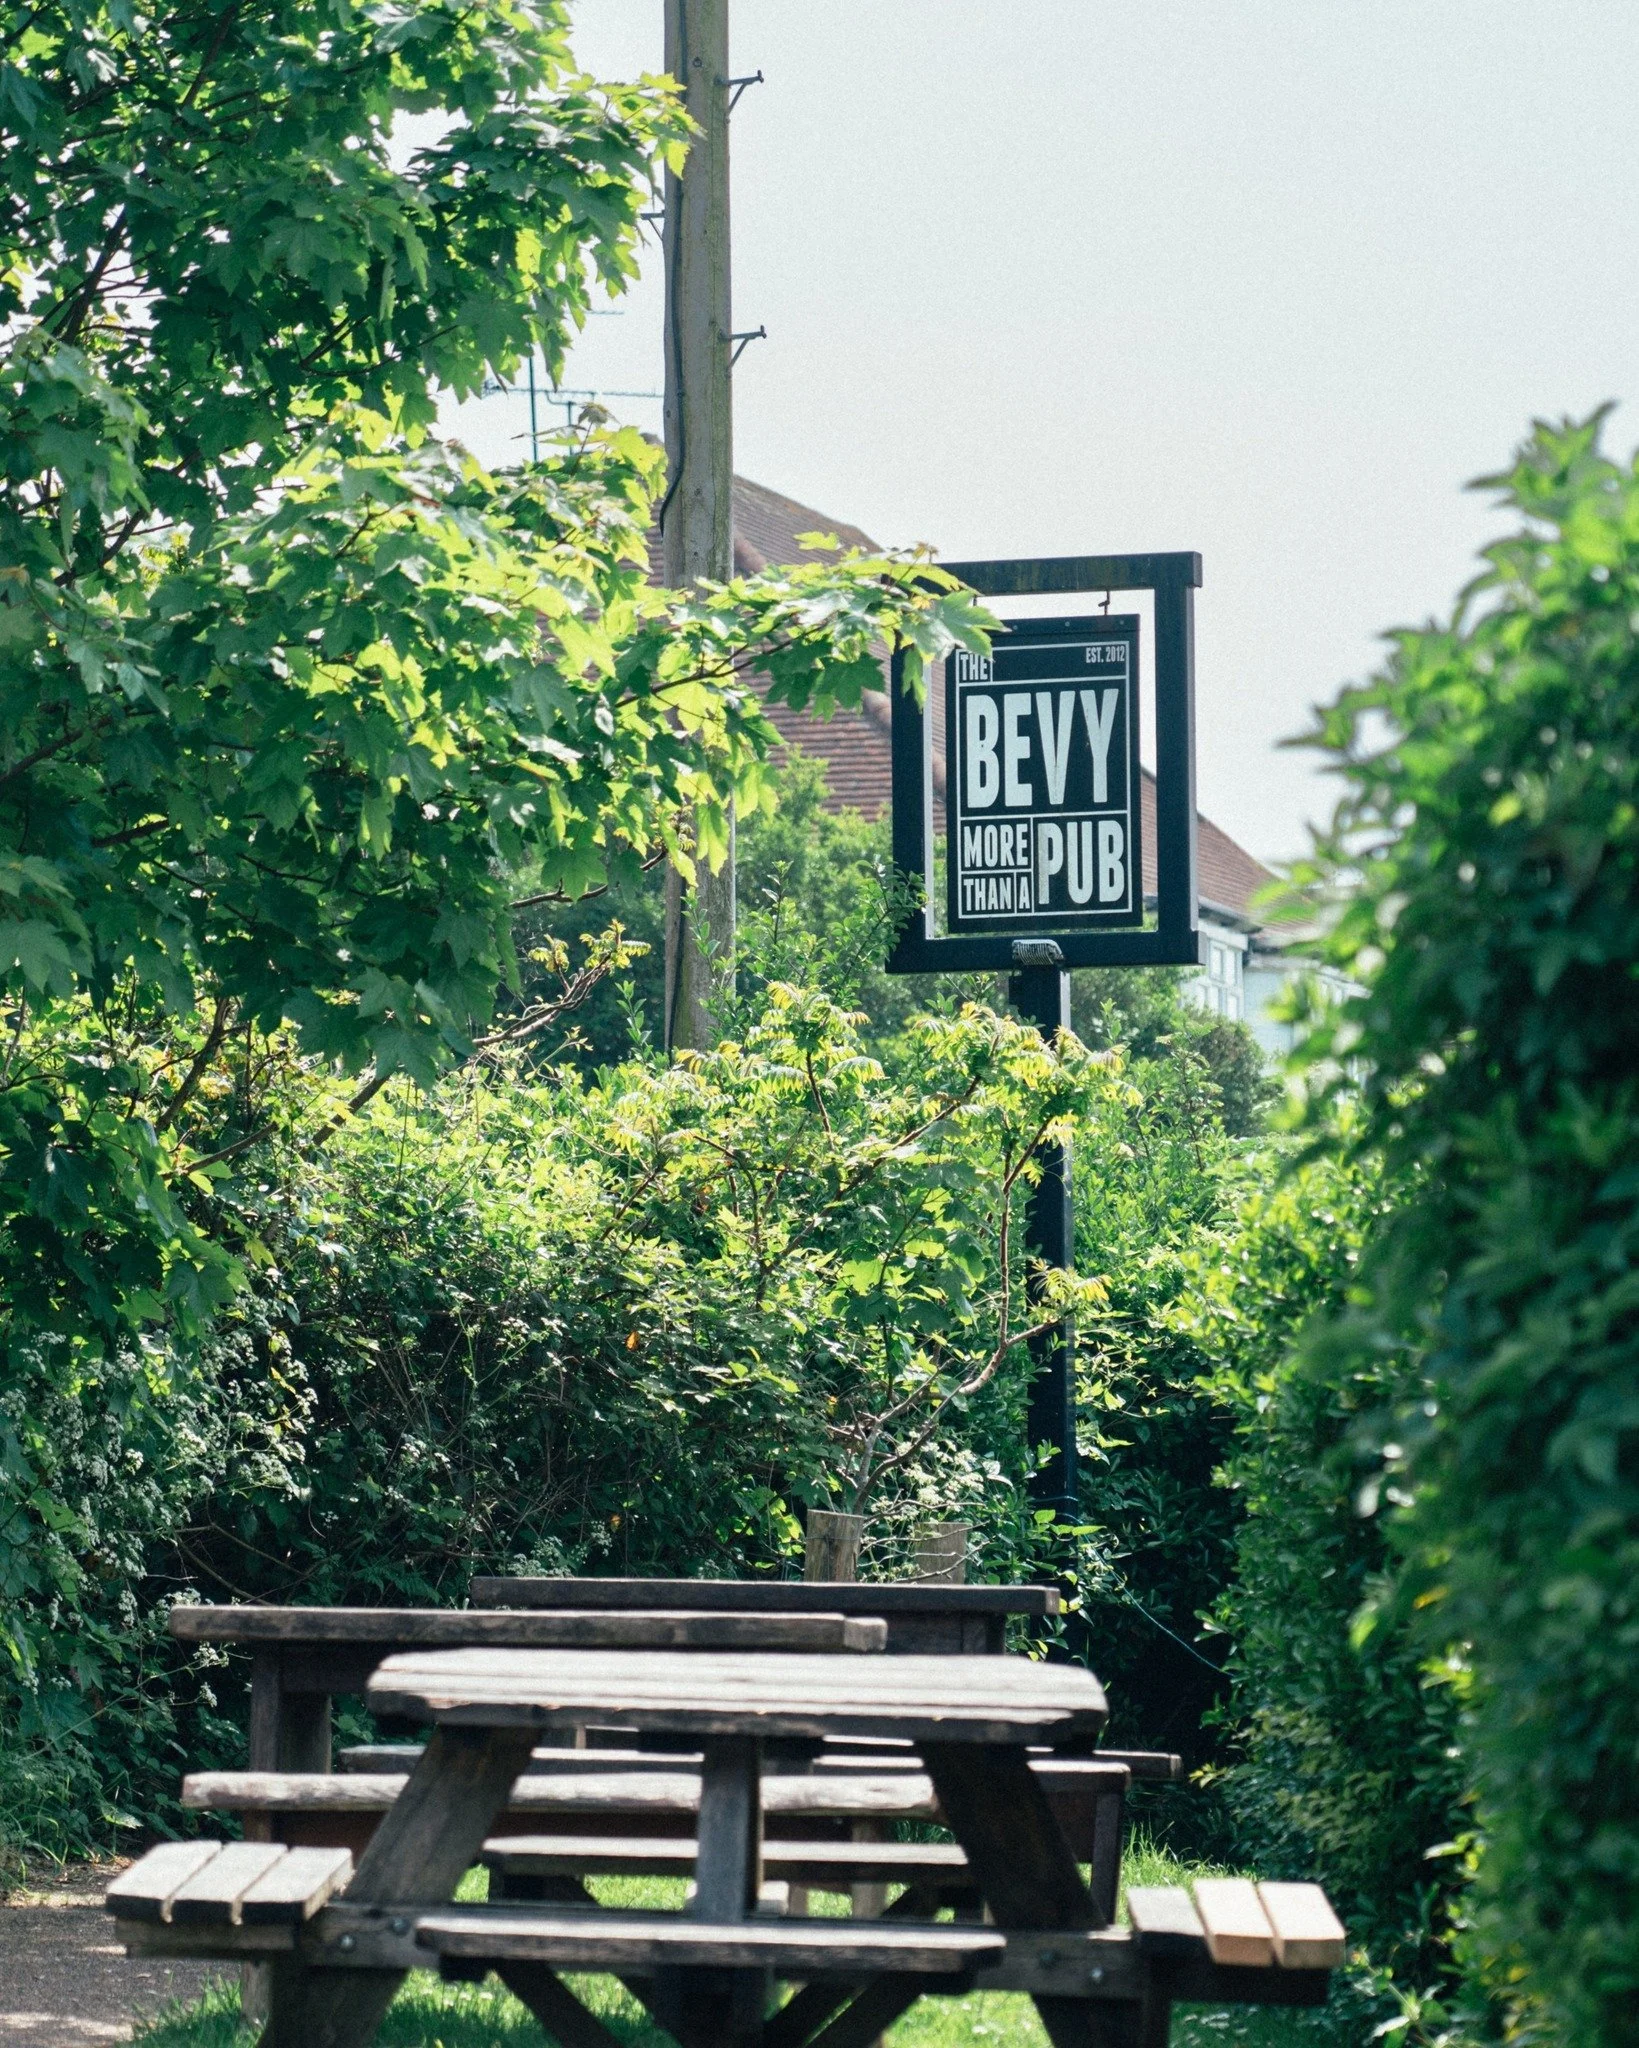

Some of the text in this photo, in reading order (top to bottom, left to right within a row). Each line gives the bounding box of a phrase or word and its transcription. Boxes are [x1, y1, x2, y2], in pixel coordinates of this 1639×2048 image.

[960, 653, 988, 681] THE
[1085, 645, 1125, 664] EST. 2012
[966, 688, 1119, 808] BEVY
[963, 823, 1029, 868] MORE
[1037, 820, 1125, 905] PUB
[963, 876, 1031, 911] THAN A
